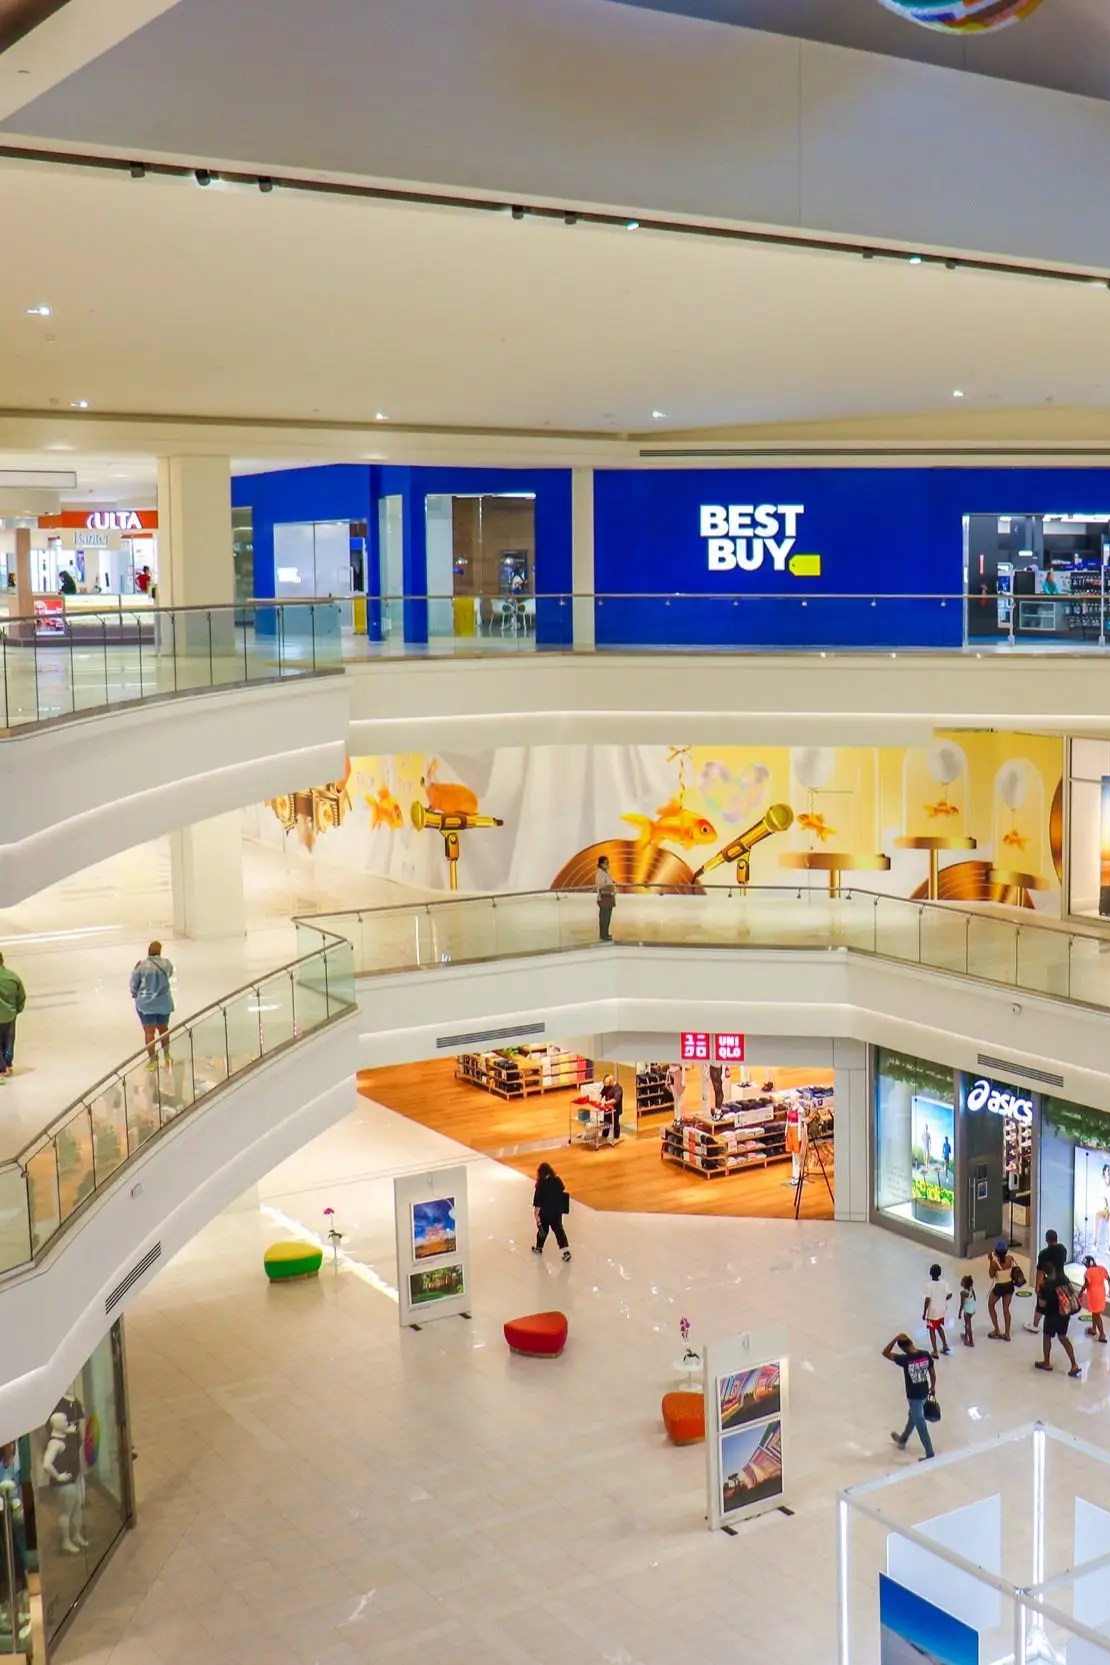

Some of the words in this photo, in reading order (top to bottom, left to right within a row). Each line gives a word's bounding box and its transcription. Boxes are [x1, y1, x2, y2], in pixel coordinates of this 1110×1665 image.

[94, 512, 143, 529] ULTA
[700, 504, 804, 537] BEST
[708, 537, 796, 571] BUY
[718, 1035, 740, 1047] UNI
[718, 1047, 742, 1059] QLO
[987, 1091, 1033, 1123] asics
